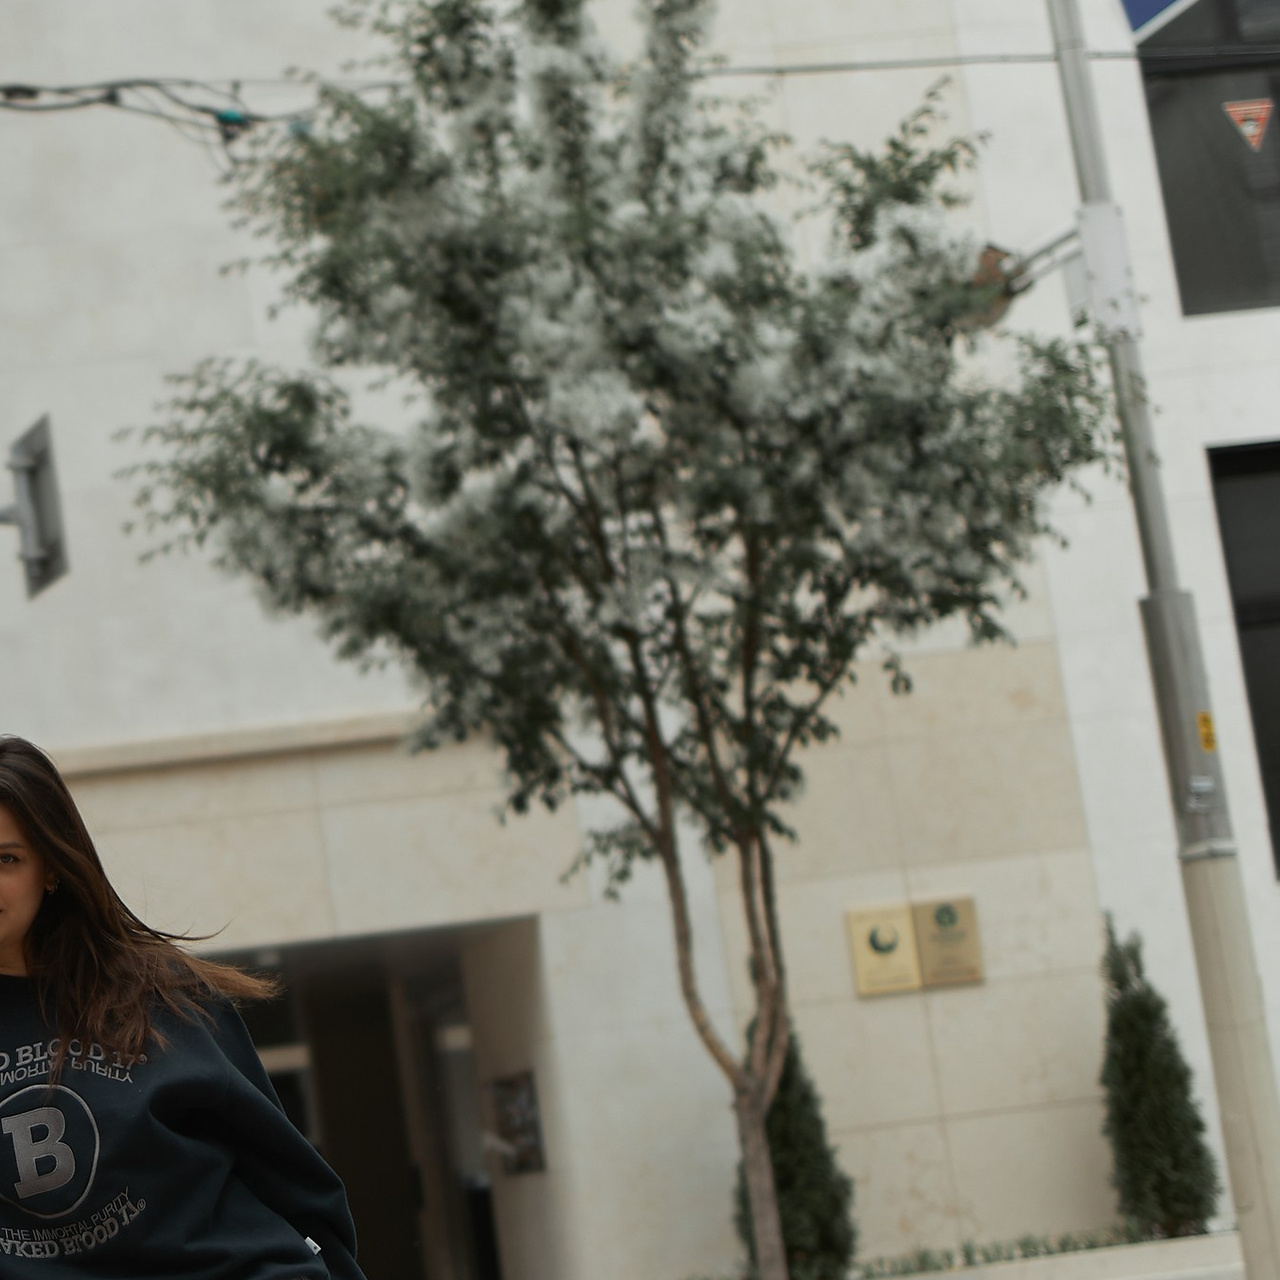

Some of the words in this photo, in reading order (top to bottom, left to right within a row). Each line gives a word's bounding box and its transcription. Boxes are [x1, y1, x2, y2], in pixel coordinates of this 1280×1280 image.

[15, 1037, 106, 1066] BLOOD
[0, 1106, 76, 1200] B
[1, 1227, 32, 1241] THE
[32, 1219, 93, 1241] IMMORTAL
[90, 1186, 131, 1224] PURITY
